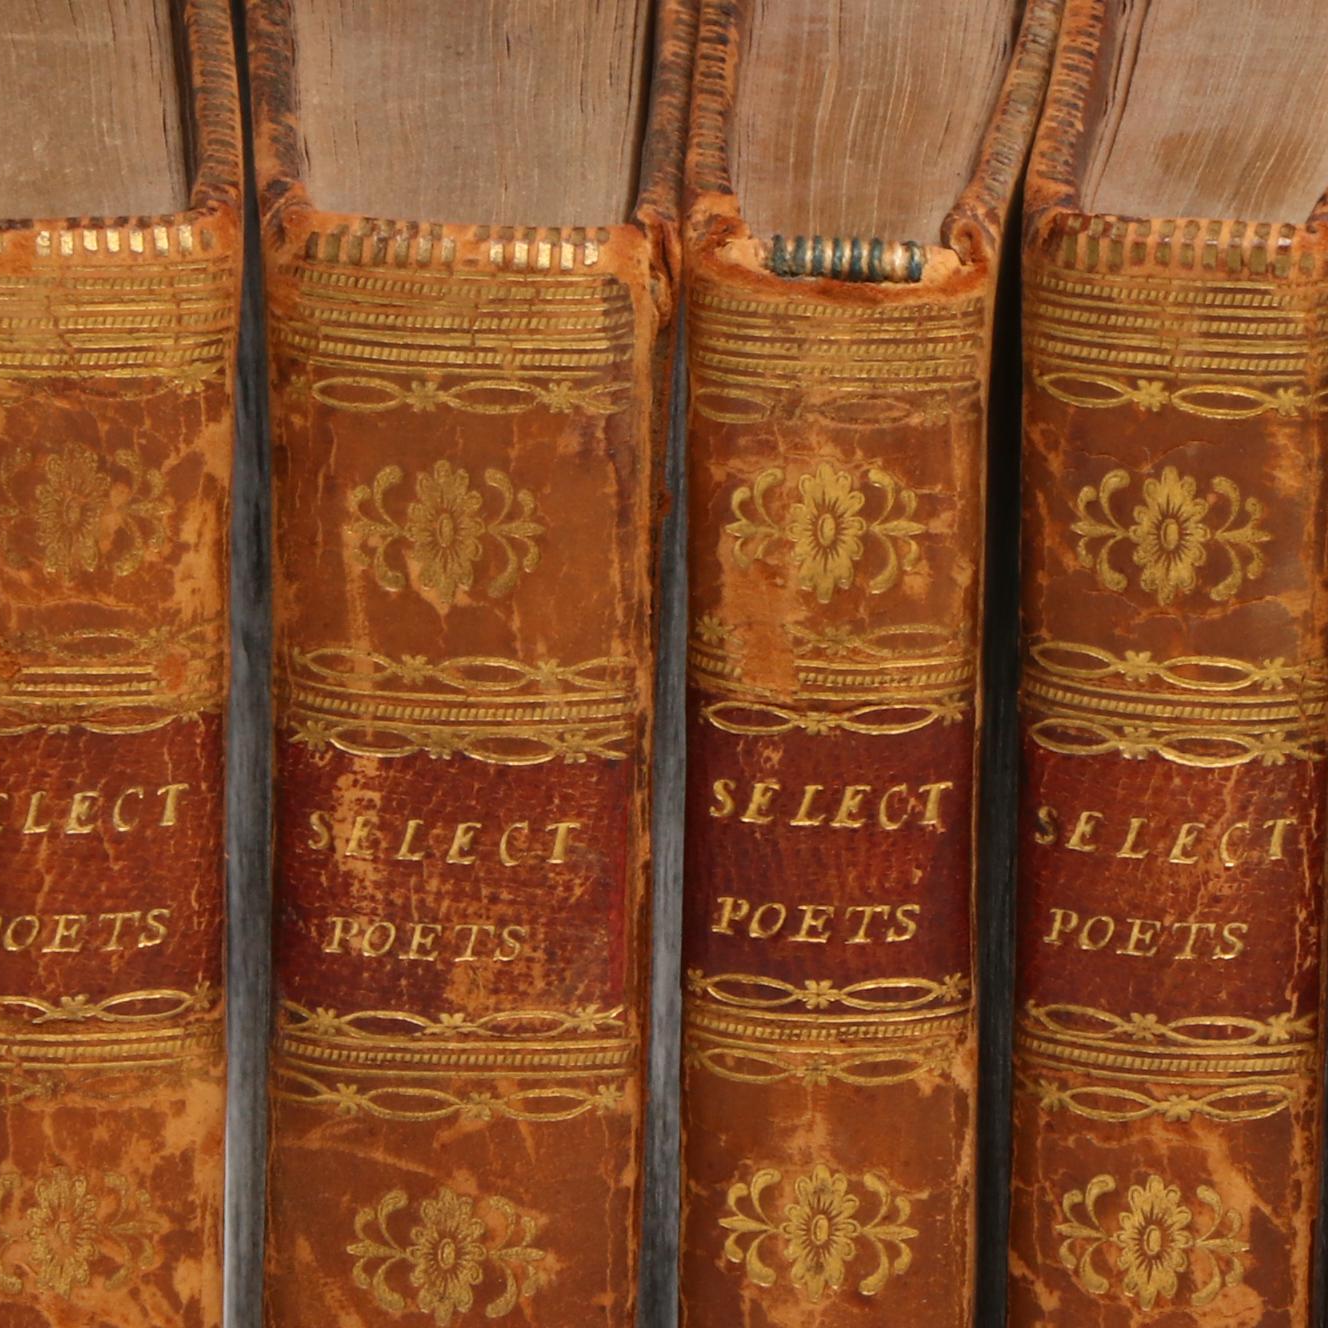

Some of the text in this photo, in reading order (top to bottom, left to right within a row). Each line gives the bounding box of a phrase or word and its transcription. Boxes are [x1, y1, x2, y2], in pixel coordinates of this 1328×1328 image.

[709, 778, 954, 830] SELECT
[307, 810, 581, 868] SELECT
[1035, 806, 1298, 867] SELECT
[324, 917, 525, 963] POETS
[712, 897, 920, 944] POETS
[1042, 908, 1248, 960] POETS
